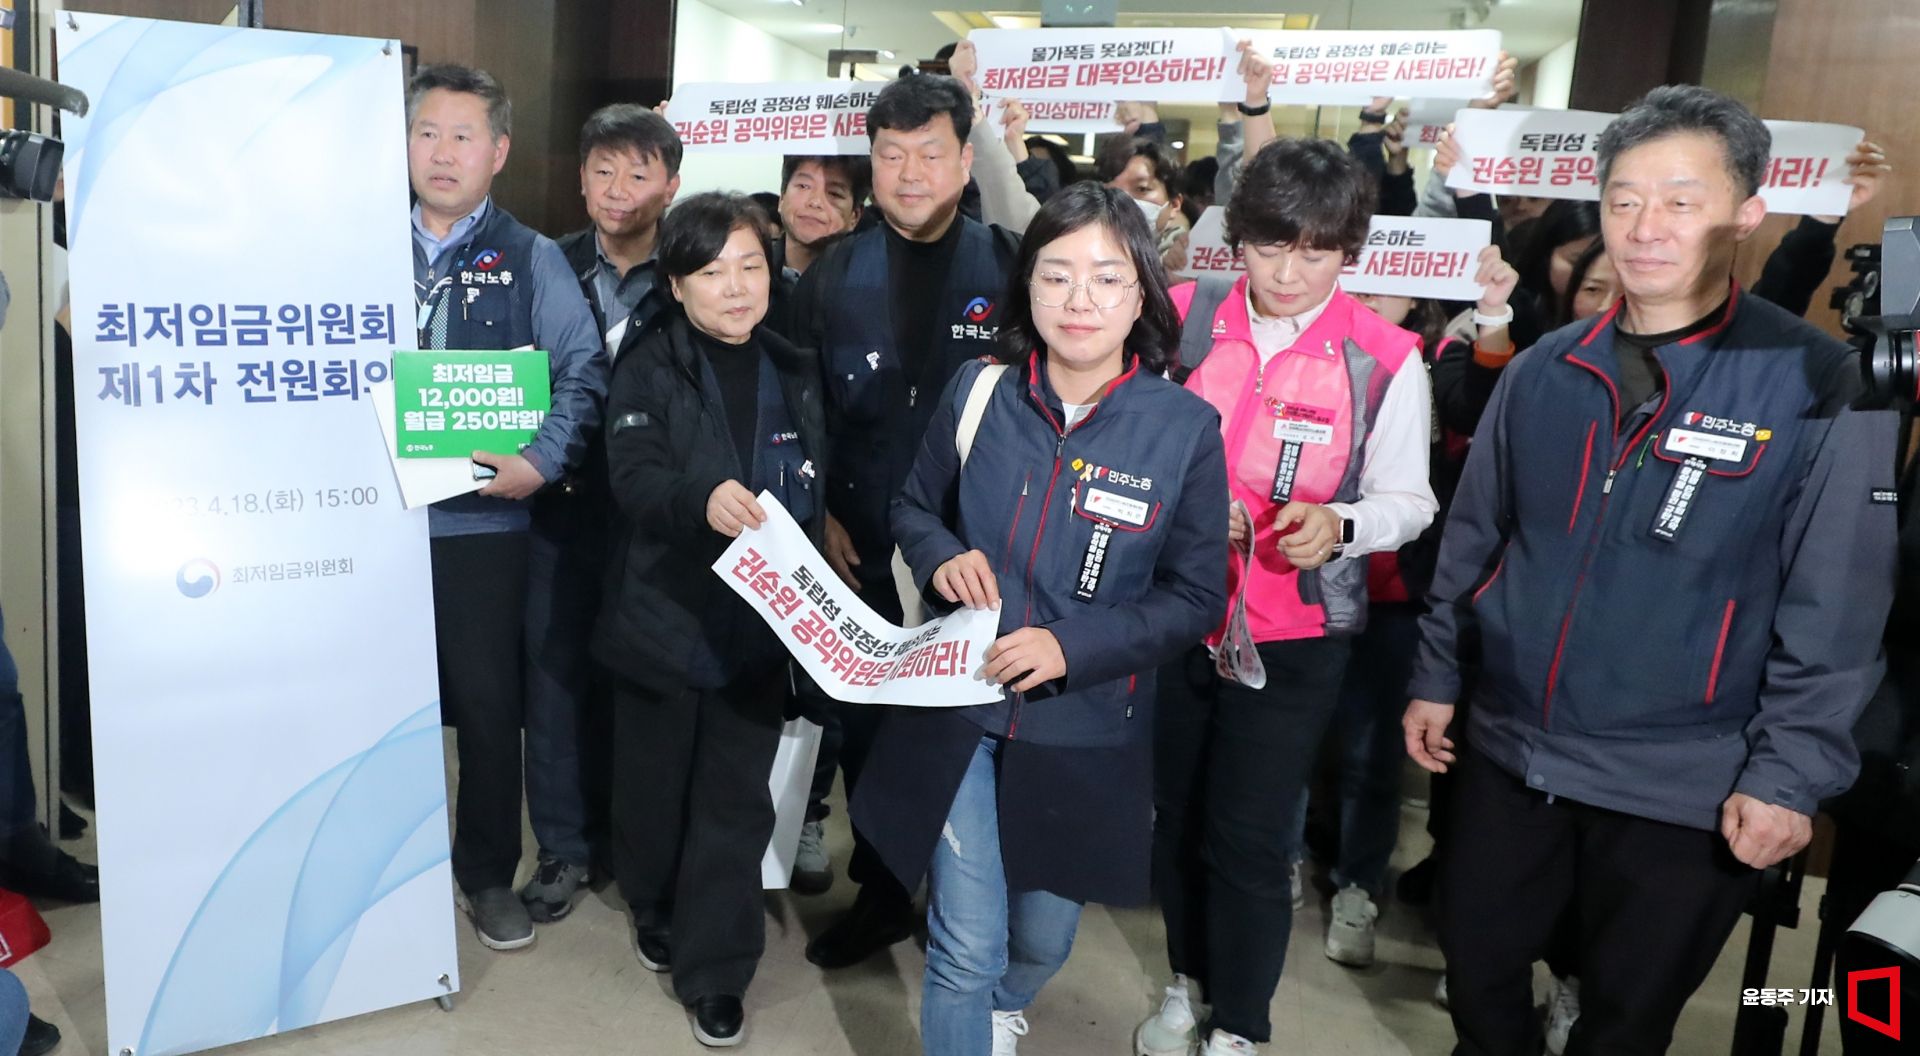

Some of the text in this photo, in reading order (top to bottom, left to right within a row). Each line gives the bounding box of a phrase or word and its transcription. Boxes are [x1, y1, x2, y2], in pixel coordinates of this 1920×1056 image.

[1031, 40, 1174, 62] 물가폭등 못살겠다!
[1273, 41, 1448, 60] 독립성 공정성 훼손하는
[983, 57, 1227, 90] 최저임금 대폭인상하라!
[1295, 59, 1389, 85] 공익위원은
[1393, 57, 1486, 82] 사퇴하라!
[709, 99, 757, 115] 독립성
[762, 96, 811, 113] 공정성
[675, 119, 729, 145] 권순원
[734, 113, 828, 143] 공익위원은
[1520, 133, 1586, 152] 독립성
[1472, 157, 1545, 185] 권순원
[1364, 250, 1470, 278] 사퇴하라!
[461, 270, 513, 286] 한국노총
[95, 302, 396, 347] 최저임금위원회
[97, 361, 218, 407] 제1차
[432, 363, 514, 384] 최저임금
[418, 387, 524, 410] 12,000원!
[403, 410, 545, 431] 월급 250만원!
[1701, 415, 1757, 437] 민주노총
[1108, 470, 1153, 491] 민주노총
[315, 482, 379, 508] 15:00
[232, 557, 354, 584] 최저임금위원회
[731, 547, 804, 620] 권순원
[791, 610, 896, 687] 공익위원은
[790, 564, 842, 621] 독립성
[839, 615, 898, 659] 공정성
